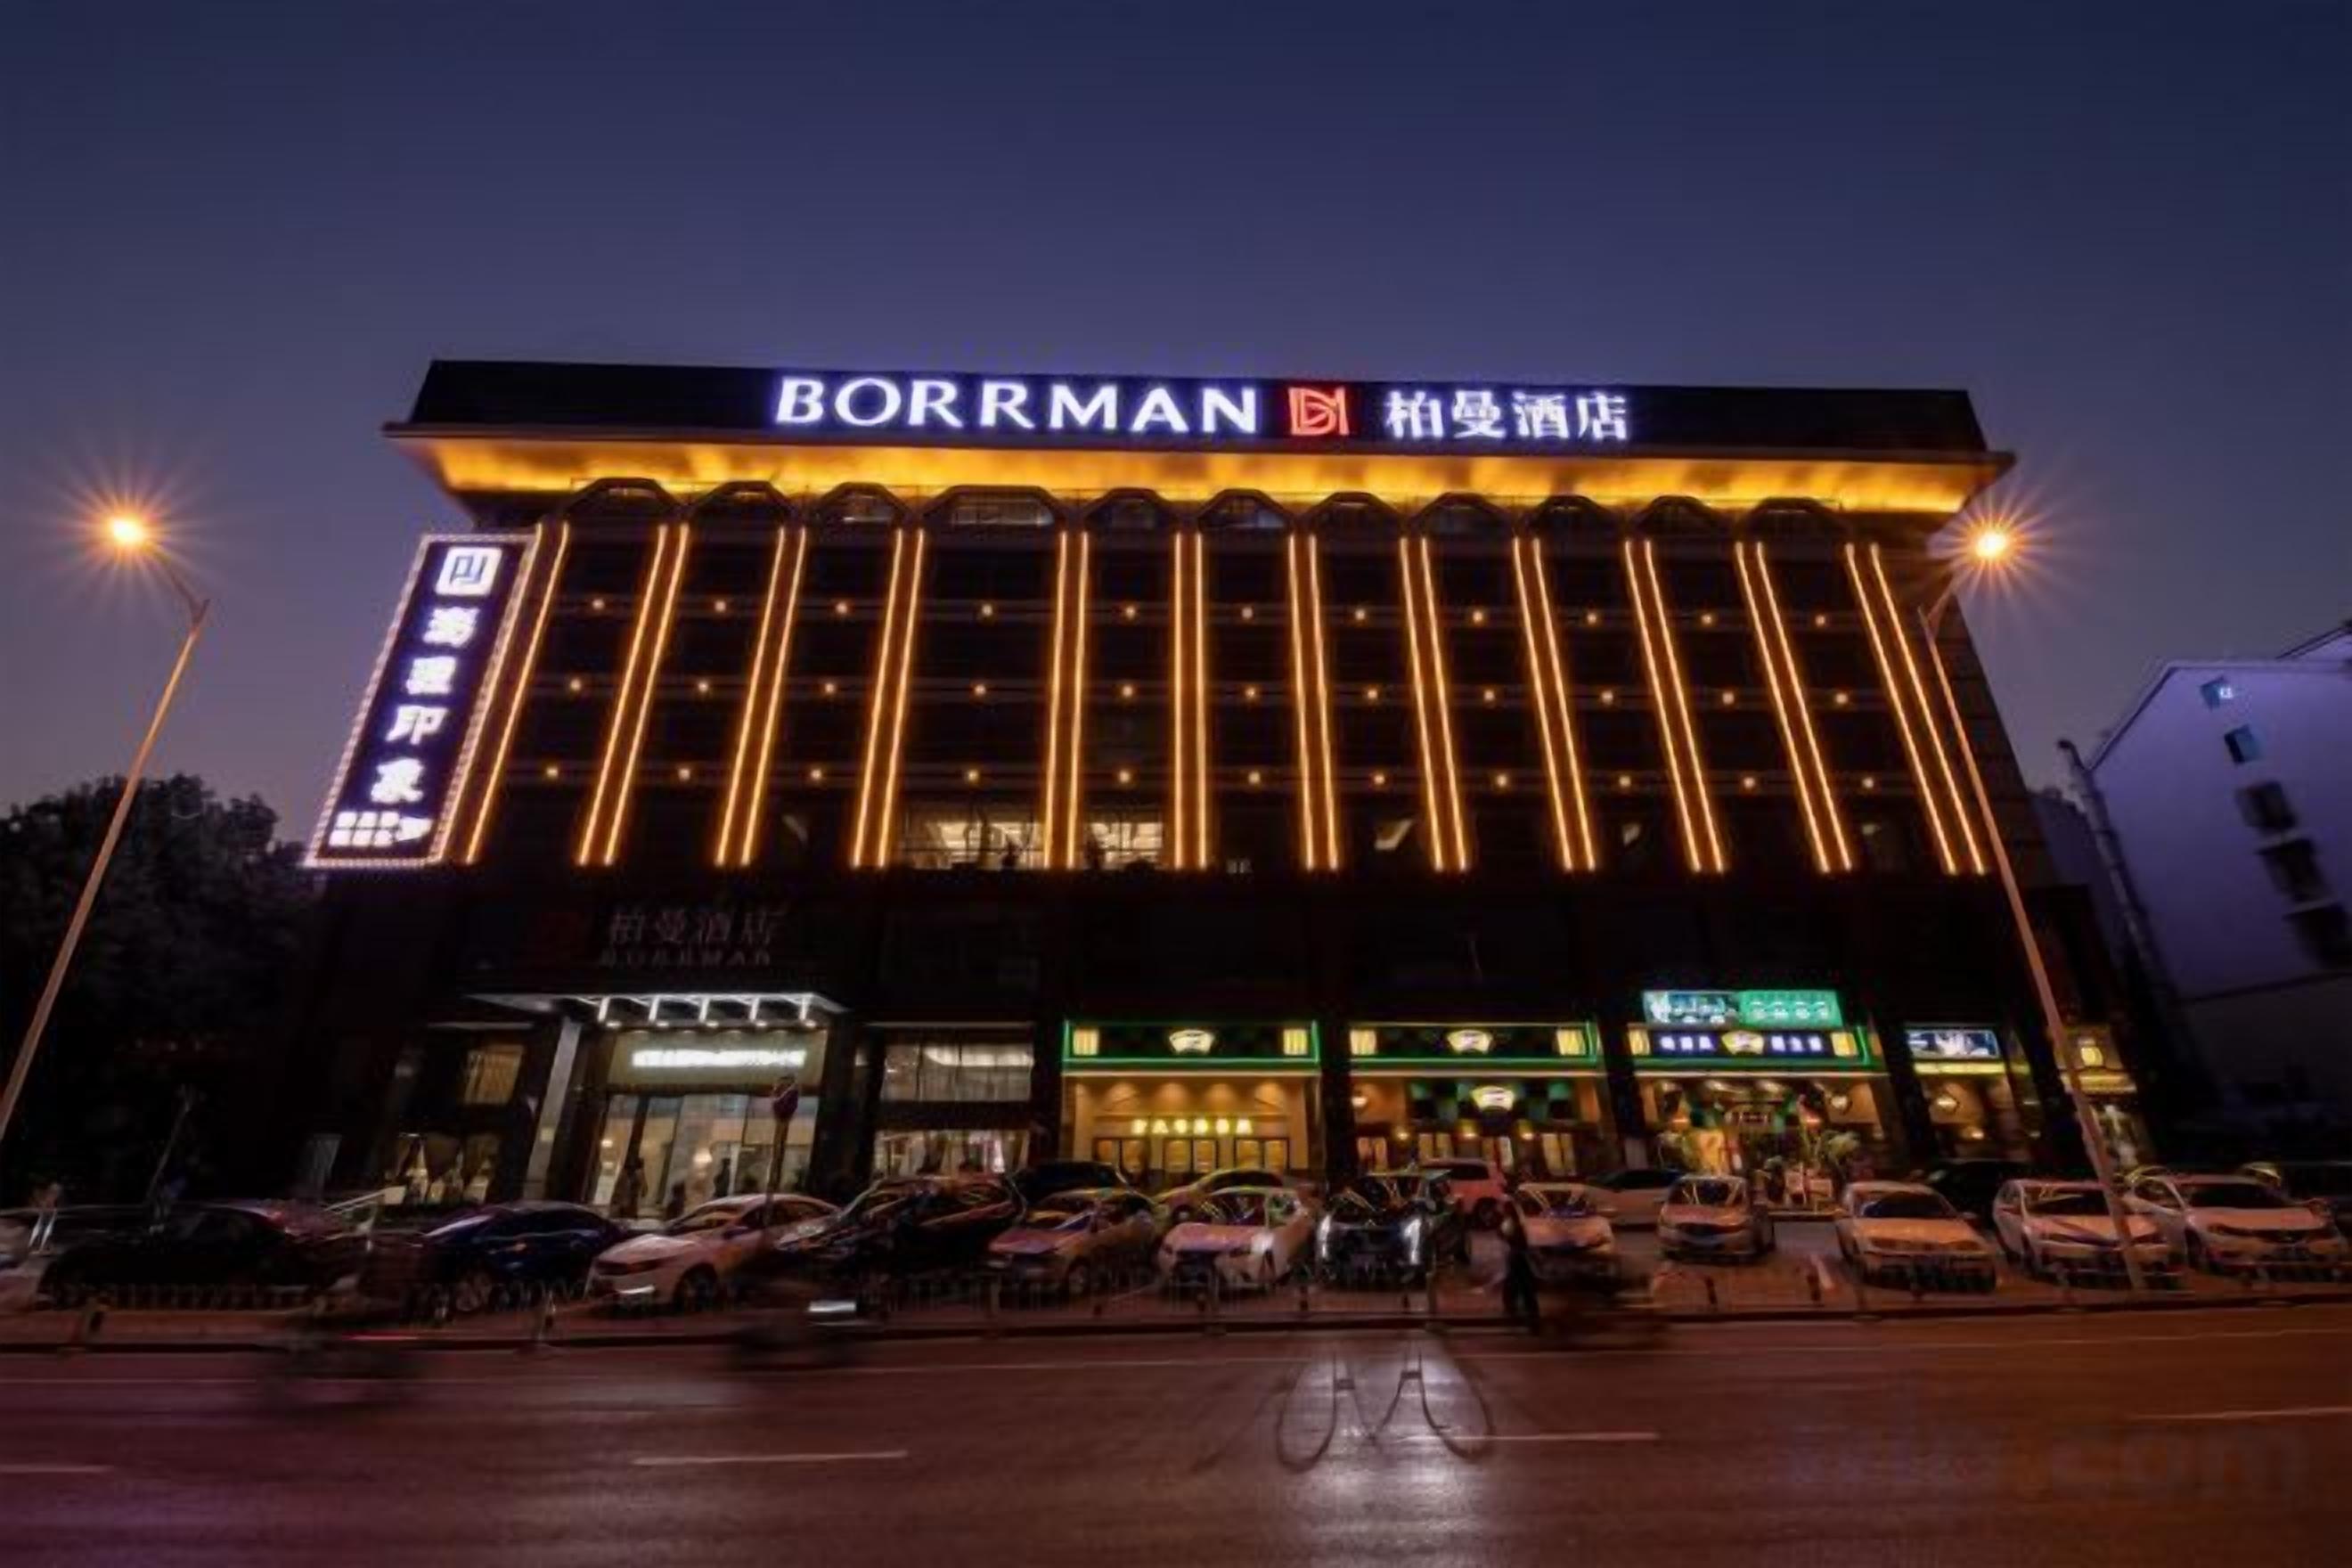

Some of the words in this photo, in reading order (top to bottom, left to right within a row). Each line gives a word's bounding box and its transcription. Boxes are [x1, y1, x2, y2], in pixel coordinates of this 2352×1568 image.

[774, 376, 1257, 434] BORRMAN
[1384, 389, 1628, 439] 柏曼酒店
